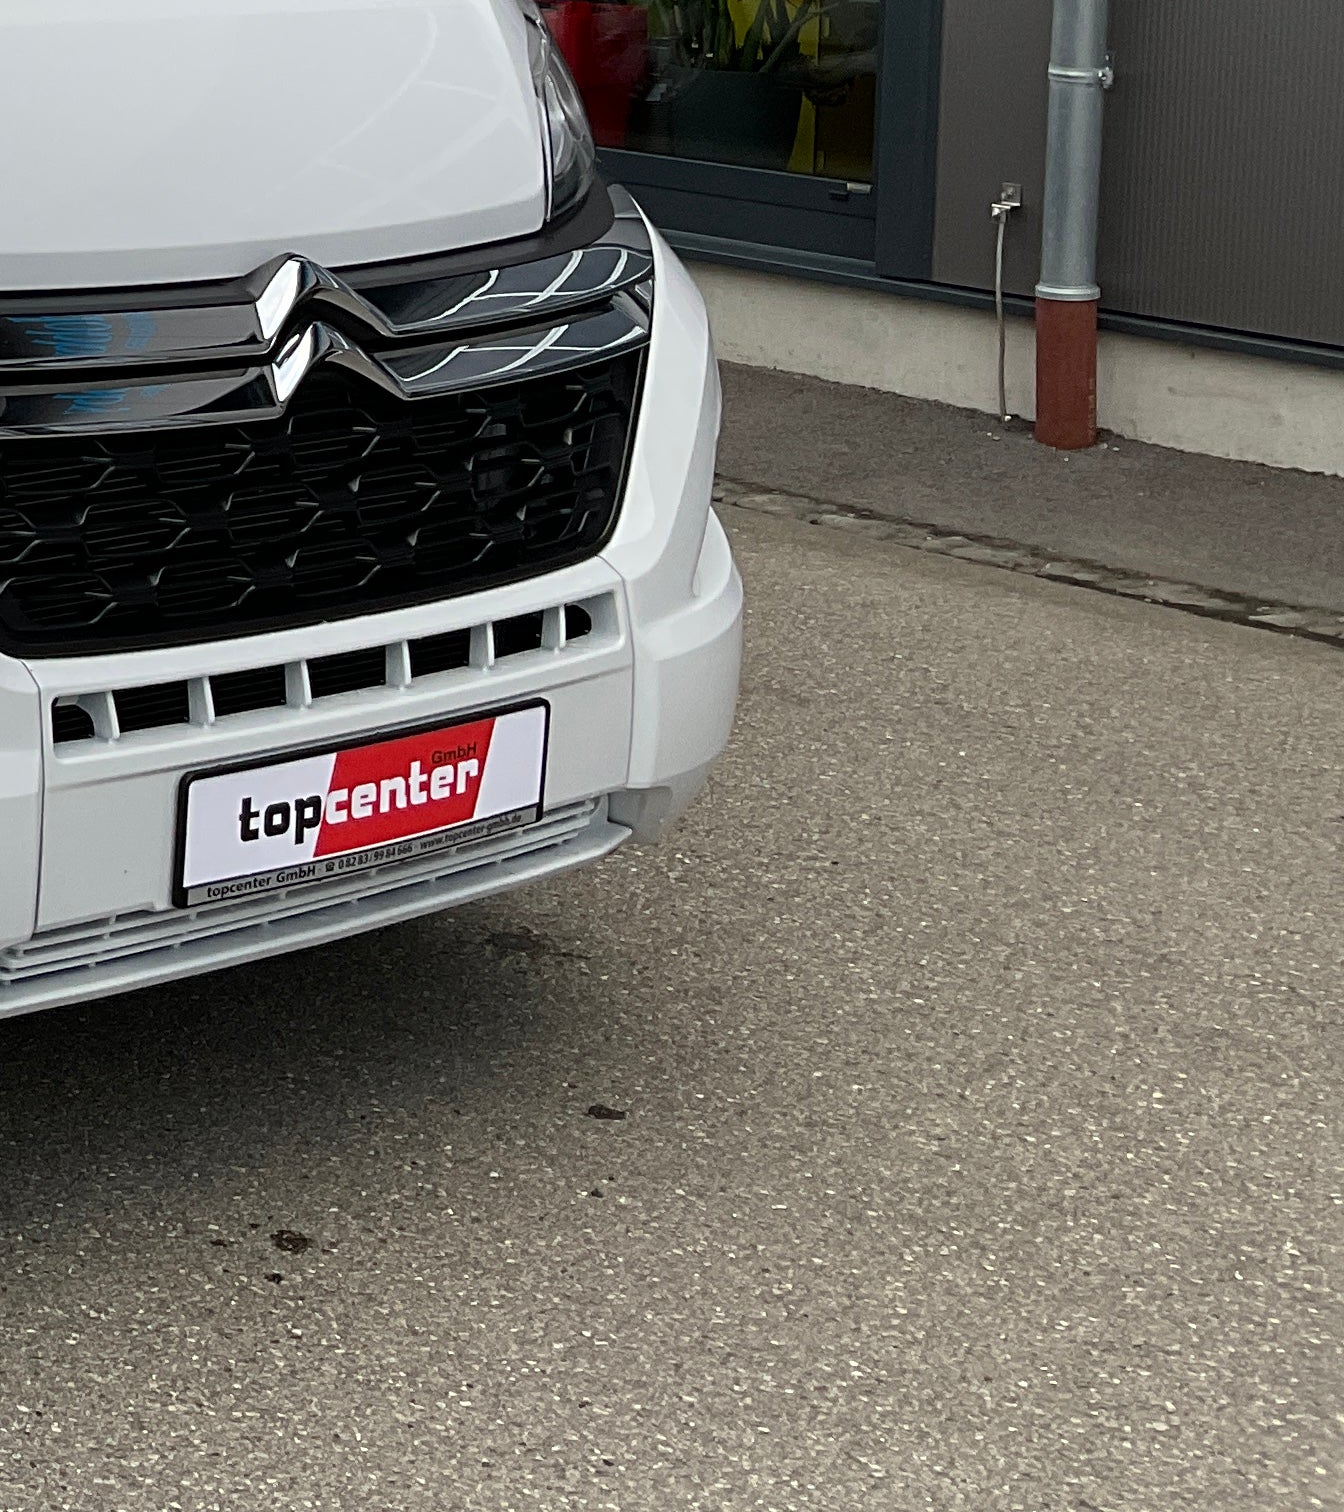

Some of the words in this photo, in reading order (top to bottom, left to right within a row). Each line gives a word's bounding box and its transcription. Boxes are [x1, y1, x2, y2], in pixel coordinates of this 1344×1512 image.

[430, 740, 478, 765] GmbH
[238, 756, 481, 846] topcenter
[206, 876, 273, 899] topcenter
[276, 864, 317, 884] GmbH
